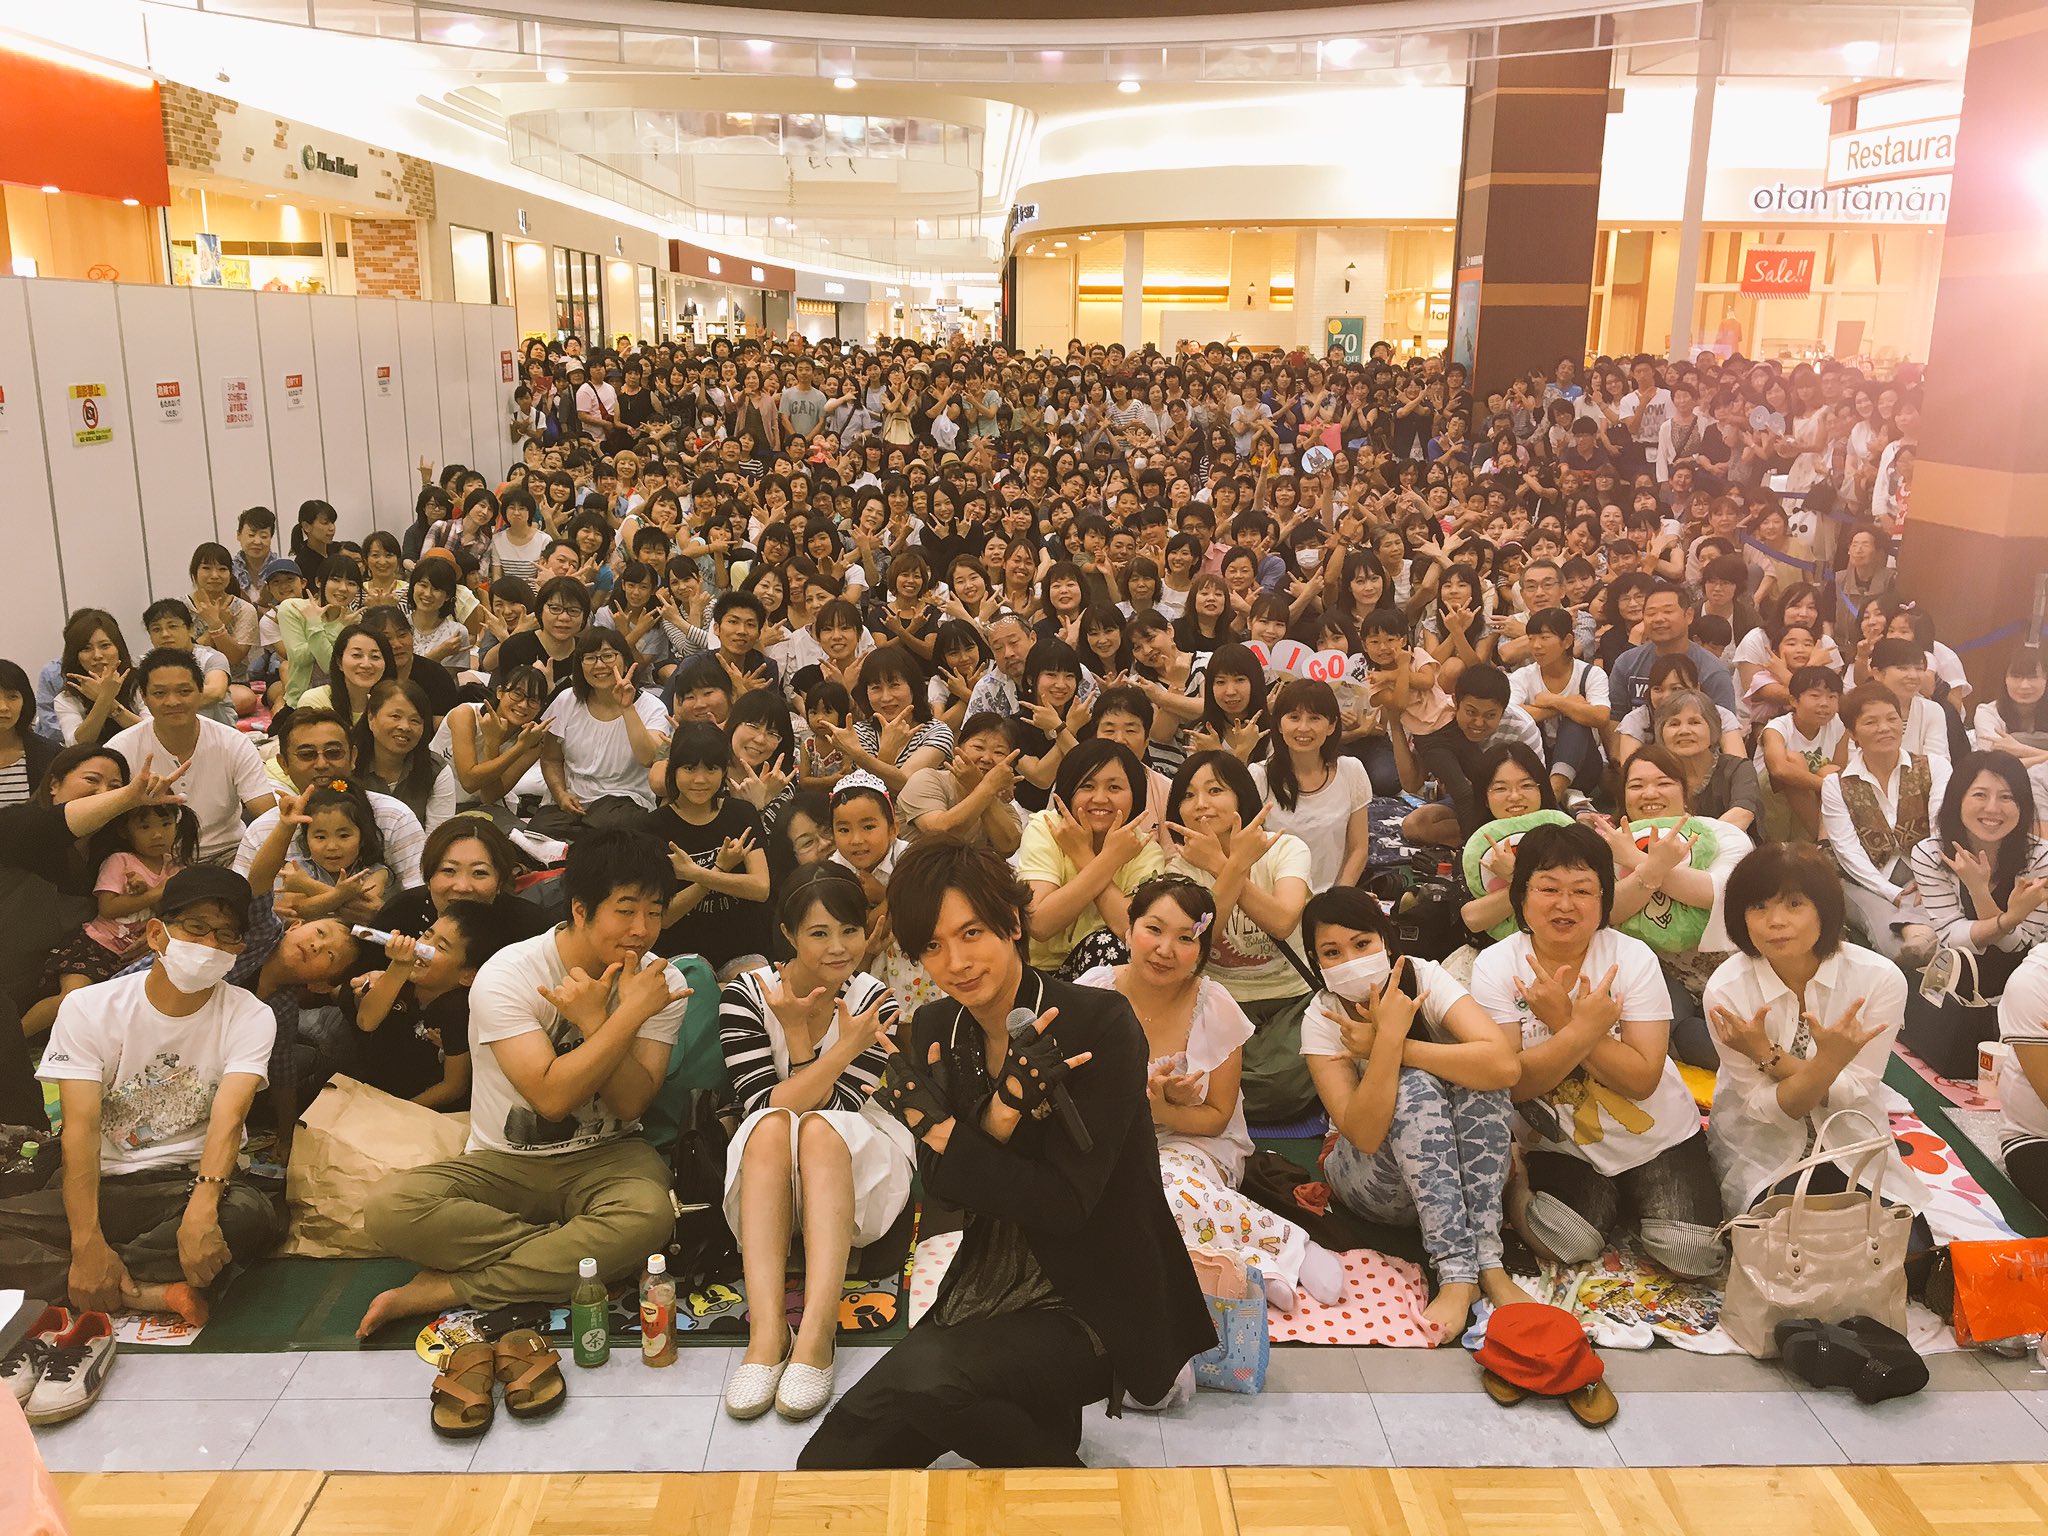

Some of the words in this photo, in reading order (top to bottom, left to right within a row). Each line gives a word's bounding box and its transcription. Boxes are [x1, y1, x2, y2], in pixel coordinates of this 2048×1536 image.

[1848, 135, 1951, 171] Restaura
[1754, 183, 1828, 210] otan
[1750, 257, 1808, 284] Sale!!
[791, 400, 816, 415] GAP
[586, 1330, 604, 1349] 茶
